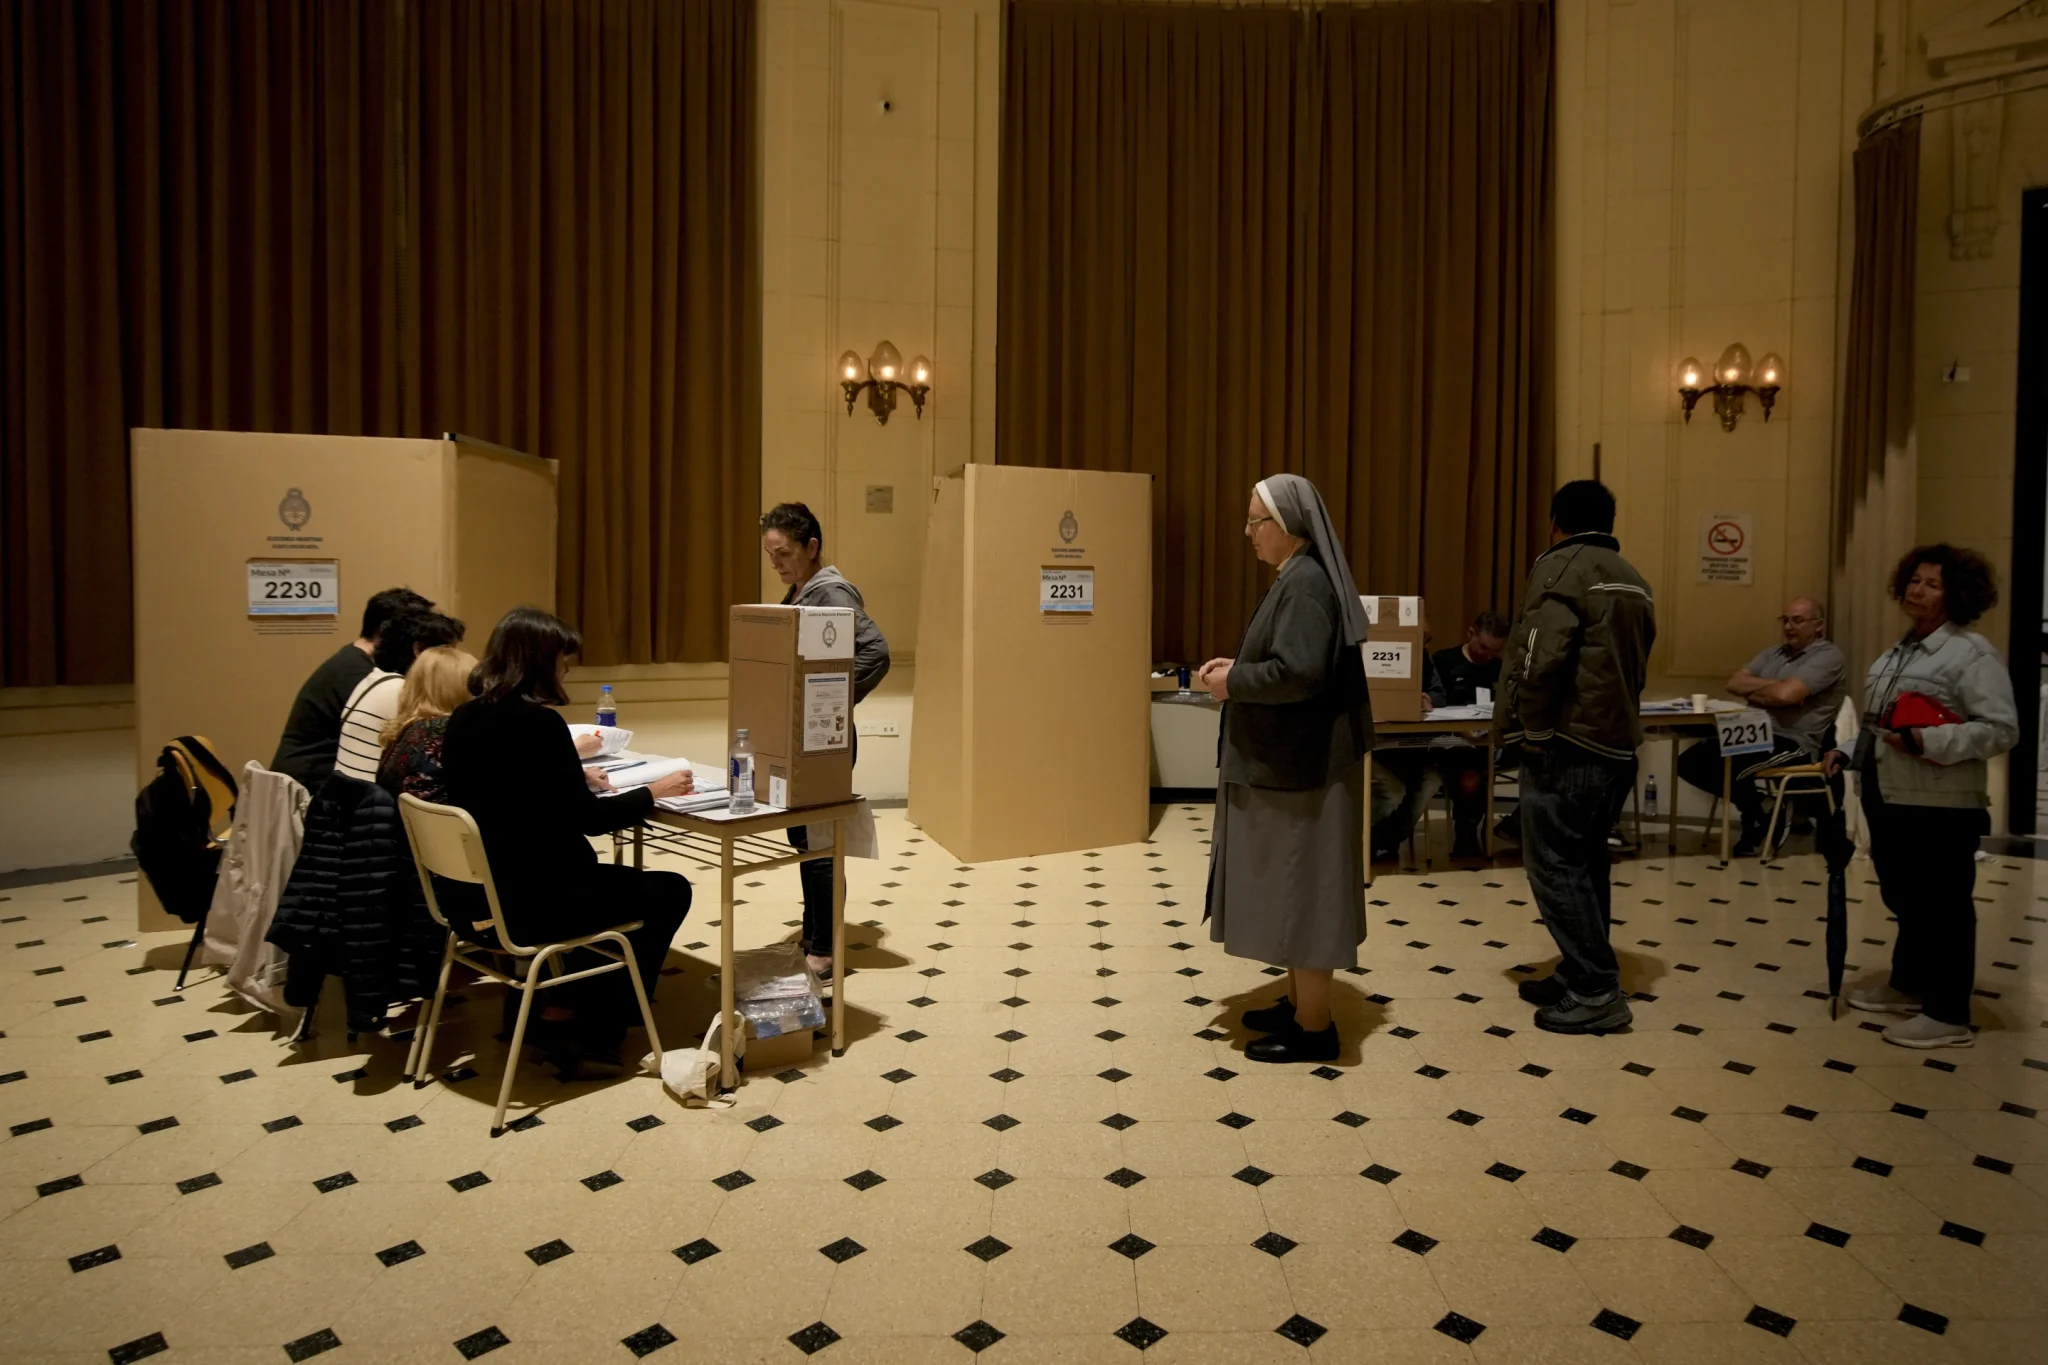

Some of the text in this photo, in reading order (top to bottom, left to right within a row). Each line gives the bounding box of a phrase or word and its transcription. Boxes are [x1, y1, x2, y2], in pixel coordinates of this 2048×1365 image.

[250, 569, 276, 577] Mesa
[264, 581, 322, 599] 2230
[1050, 584, 1084, 599] 2231
[1372, 651, 1400, 661] 2231
[1722, 722, 1768, 747] 2231
